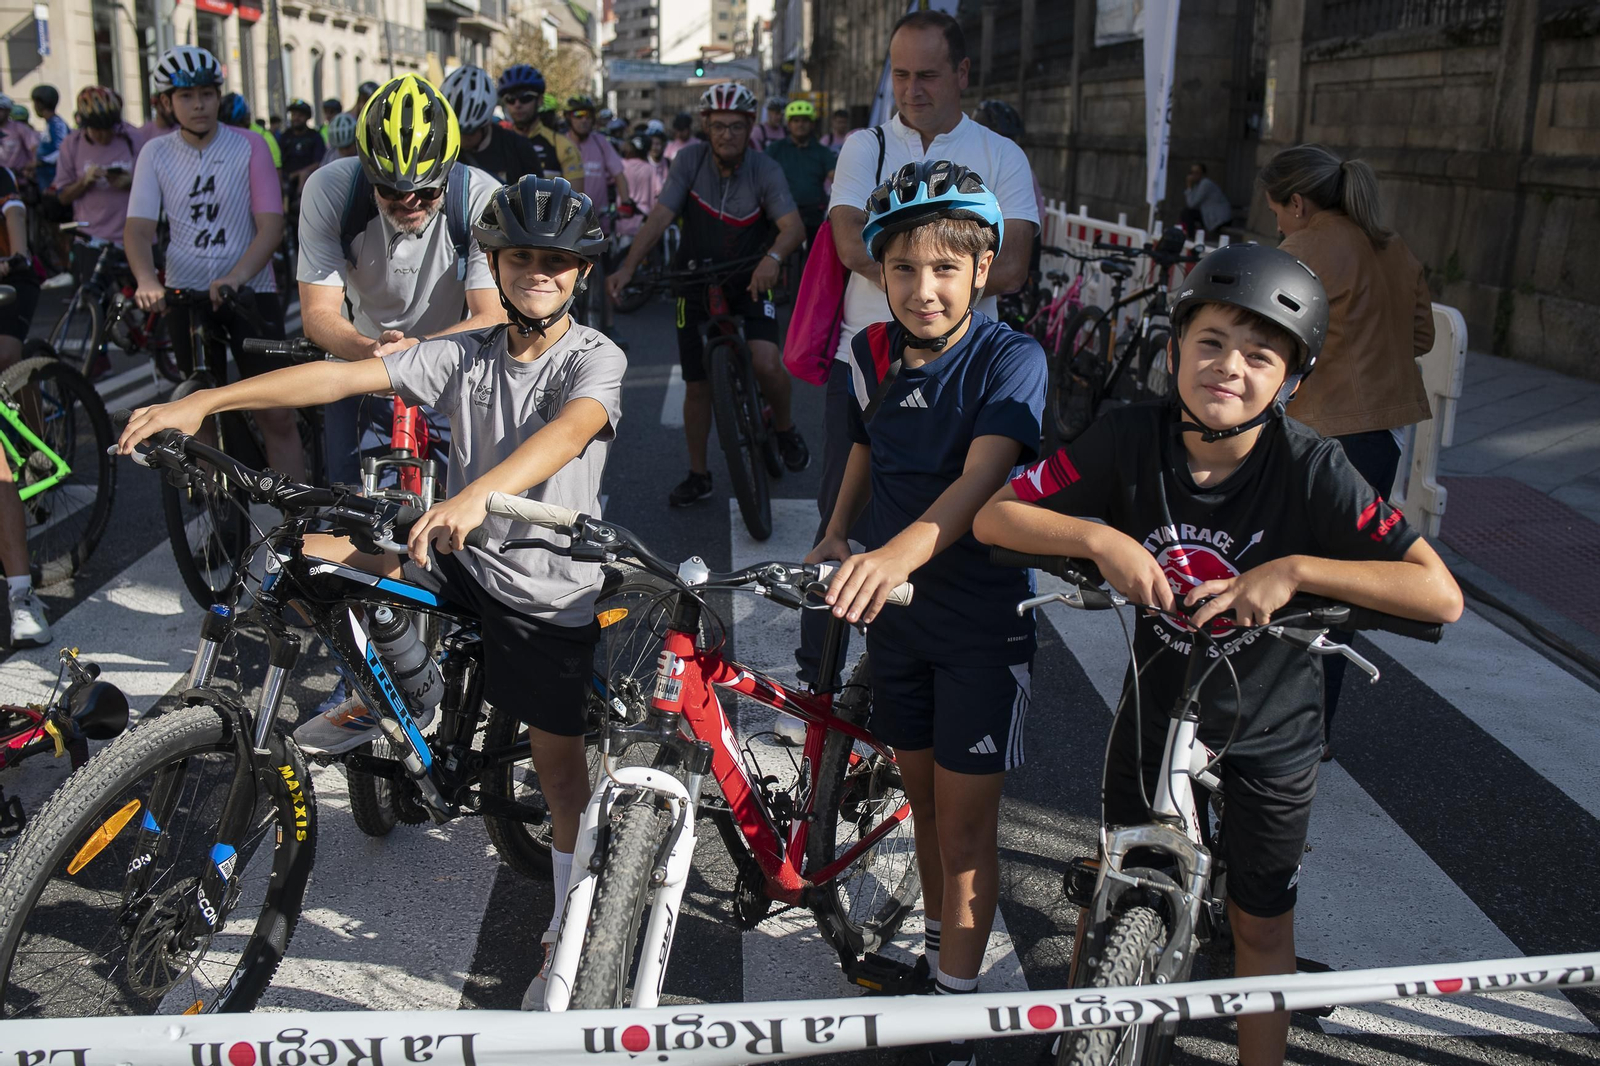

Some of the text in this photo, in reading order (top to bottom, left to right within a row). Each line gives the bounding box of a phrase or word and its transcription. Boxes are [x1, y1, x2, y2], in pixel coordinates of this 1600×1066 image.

[189, 174, 215, 198] LA
[190, 202, 220, 224] FU
[194, 228, 226, 250] GA
[1181, 523, 1234, 555] RACE
[1153, 624, 1219, 658] CAMPS
[368, 647, 416, 731] TREK
[278, 765, 307, 842] MAXXIS
[801, 1013, 883, 1048] La
[400, 1033, 480, 1066] La
